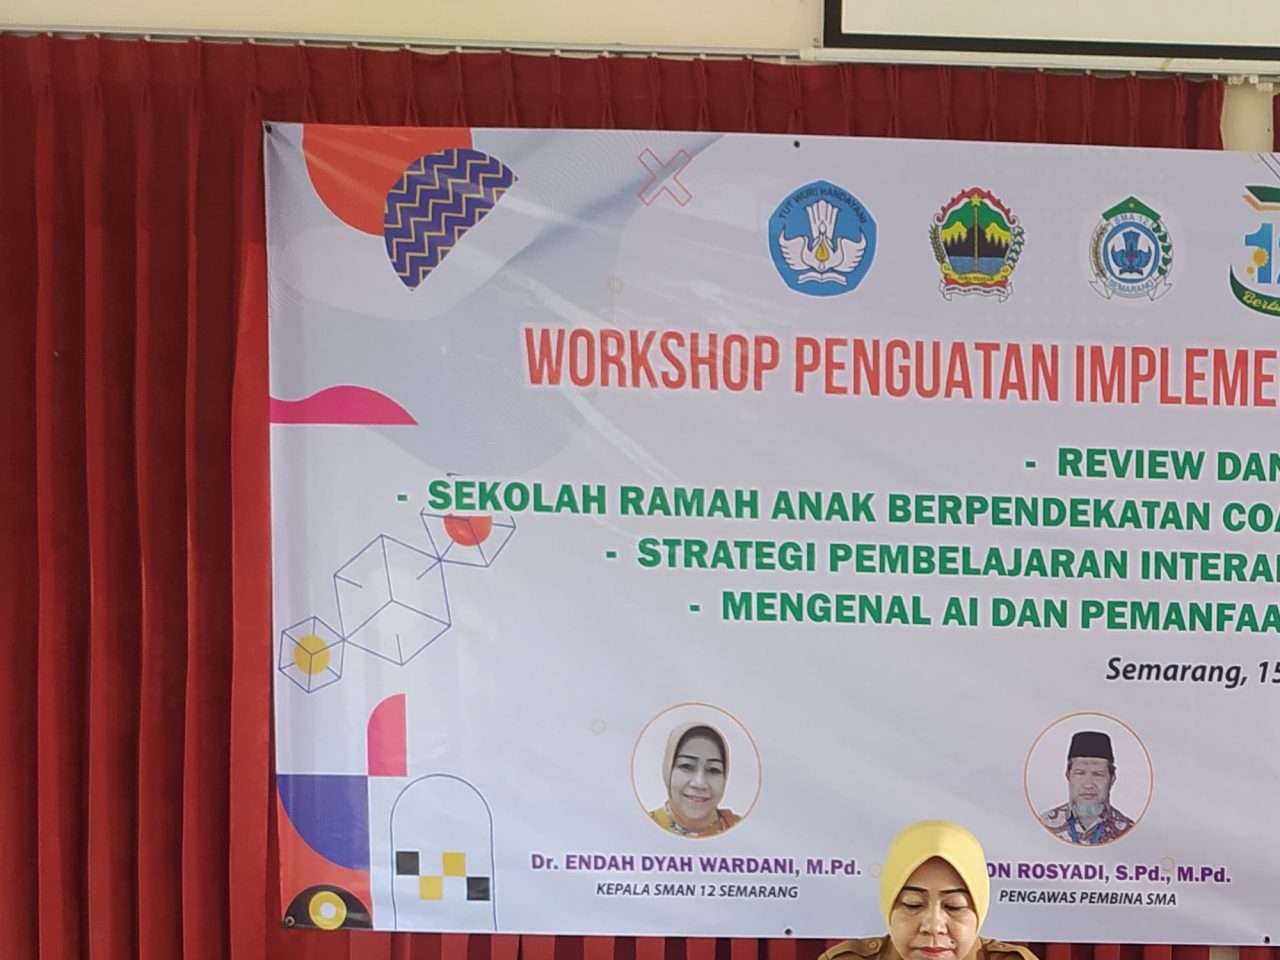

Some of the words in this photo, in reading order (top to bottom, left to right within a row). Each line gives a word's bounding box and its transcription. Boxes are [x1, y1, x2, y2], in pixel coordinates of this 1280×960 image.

[779, 200, 796, 219] TUT
[1113, 213, 1137, 225] SMA
[524, 327, 780, 392] WORKSHOP
[794, 335, 1060, 402] PENGUATAN
[1057, 447, 1205, 481] REVIEW
[427, 479, 607, 516] SEKOLAH
[619, 484, 760, 520] RAMAH
[771, 489, 876, 524] ANAK
[887, 492, 1211, 530] BERPENDEKATAN
[636, 537, 816, 573] STRATEGI
[829, 543, 1128, 580] PEMBELAJARAN
[721, 590, 933, 625] MENGENAL
[942, 595, 978, 626] AI
[991, 596, 1068, 629] DAN
[1105, 657, 1248, 689] Semarang,
[531, 853, 559, 870] Dr.
[565, 854, 634, 871] ENDAH
[641, 856, 693, 872] DYAH
[699, 857, 800, 877] WARDANI,
[806, 858, 861, 875] M.Pd.
[1016, 863, 1110, 884] ROSYADI,
[1115, 864, 1171, 885] S.Pd.,
[1175, 865, 1231, 884] M.Pd.
[597, 883, 650, 895] KEPALA
[654, 884, 695, 896] SMAN
[700, 885, 716, 897] 12
[719, 885, 798, 898] SEMARANG
[999, 889, 1077, 904] PENGAWAS
[1079, 891, 1143, 905] PEMBINA
[1145, 893, 1176, 906] SMA
